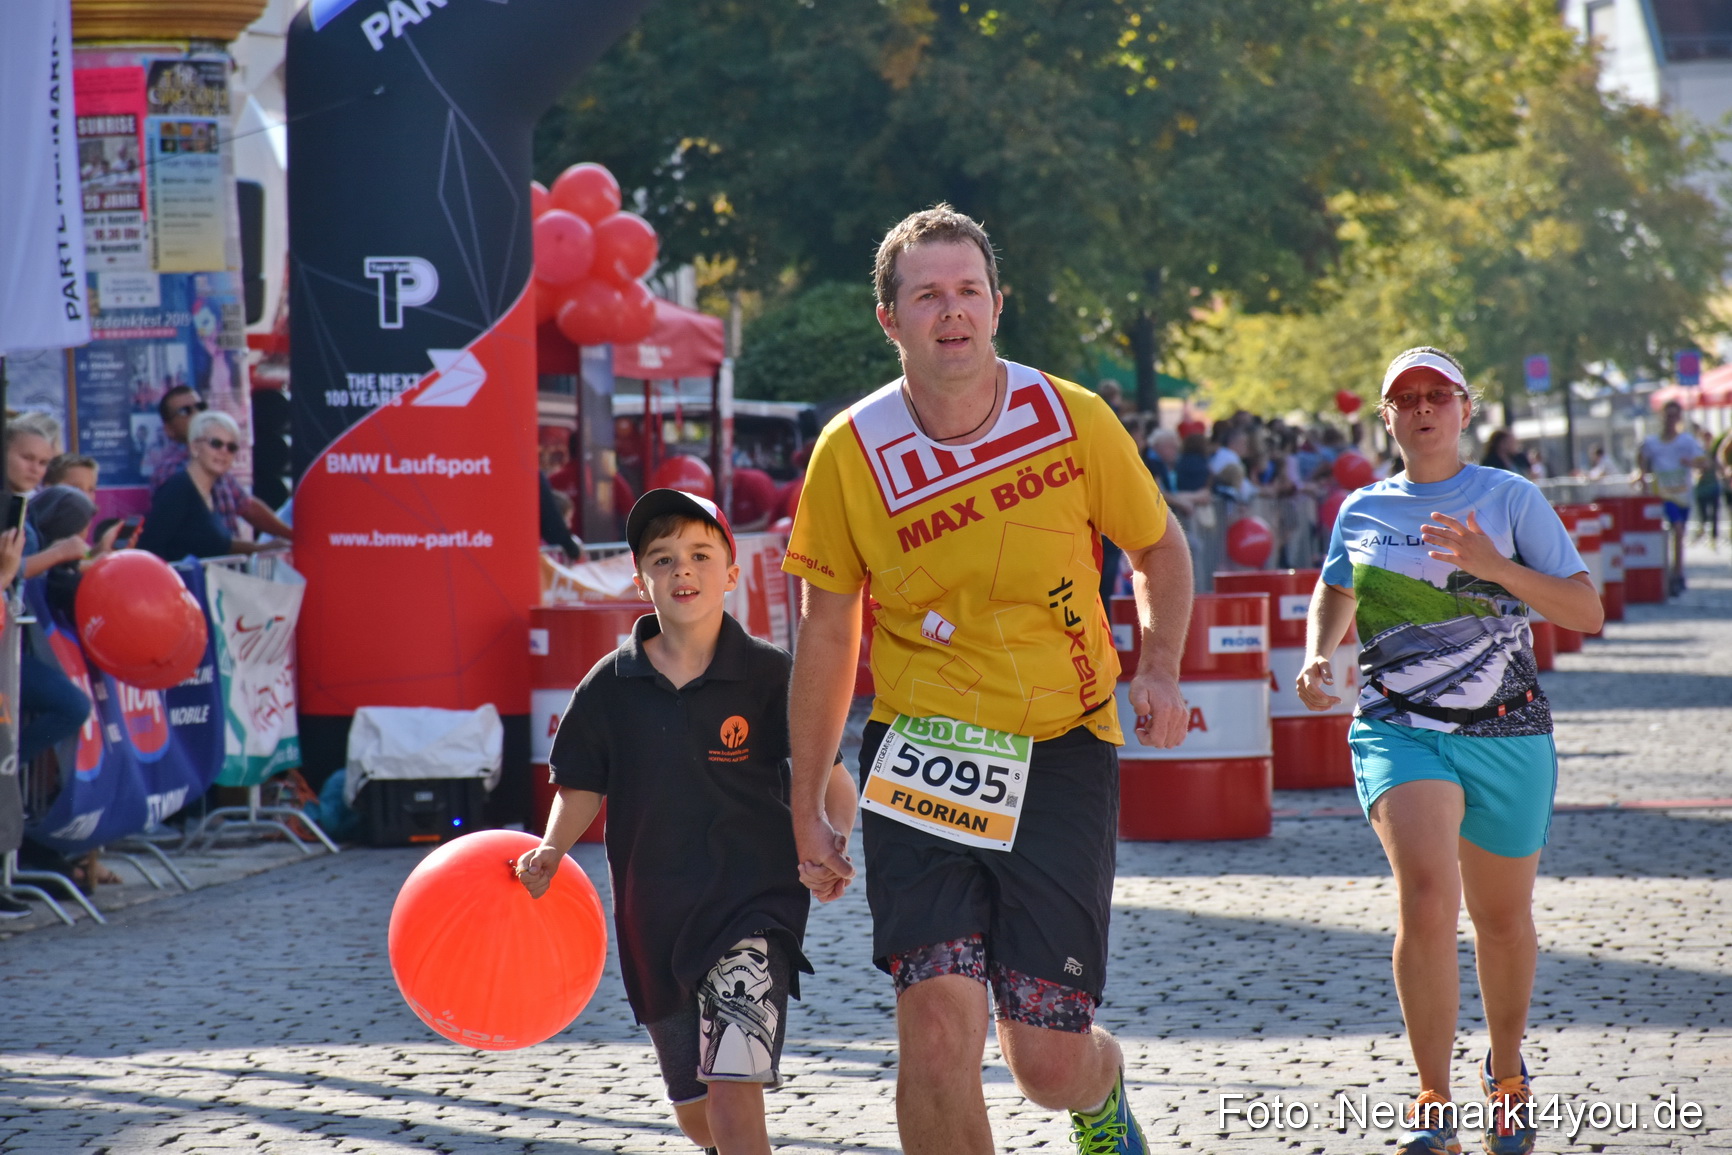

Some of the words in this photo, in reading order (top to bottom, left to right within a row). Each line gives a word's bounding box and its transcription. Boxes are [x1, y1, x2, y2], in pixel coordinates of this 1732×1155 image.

[92, 313, 162, 329] edankfest
[346, 373, 377, 390] THE
[379, 373, 420, 390] NEXT
[325, 391, 348, 406] 100
[350, 391, 403, 407] YEARS
[326, 453, 378, 473] BMW
[384, 453, 491, 478] Laufsport
[896, 496, 985, 553] MAX
[990, 457, 1085, 512] BÖGL
[328, 529, 493, 549] www.bmw-partl.de
[170, 704, 210, 726] MOBILE
[905, 716, 1014, 754] BOCK
[891, 742, 1009, 804] 5095
[1014, 772, 1020, 780] S
[890, 790, 988, 833] FLORIAN
[1063, 963, 1083, 976] PRO
